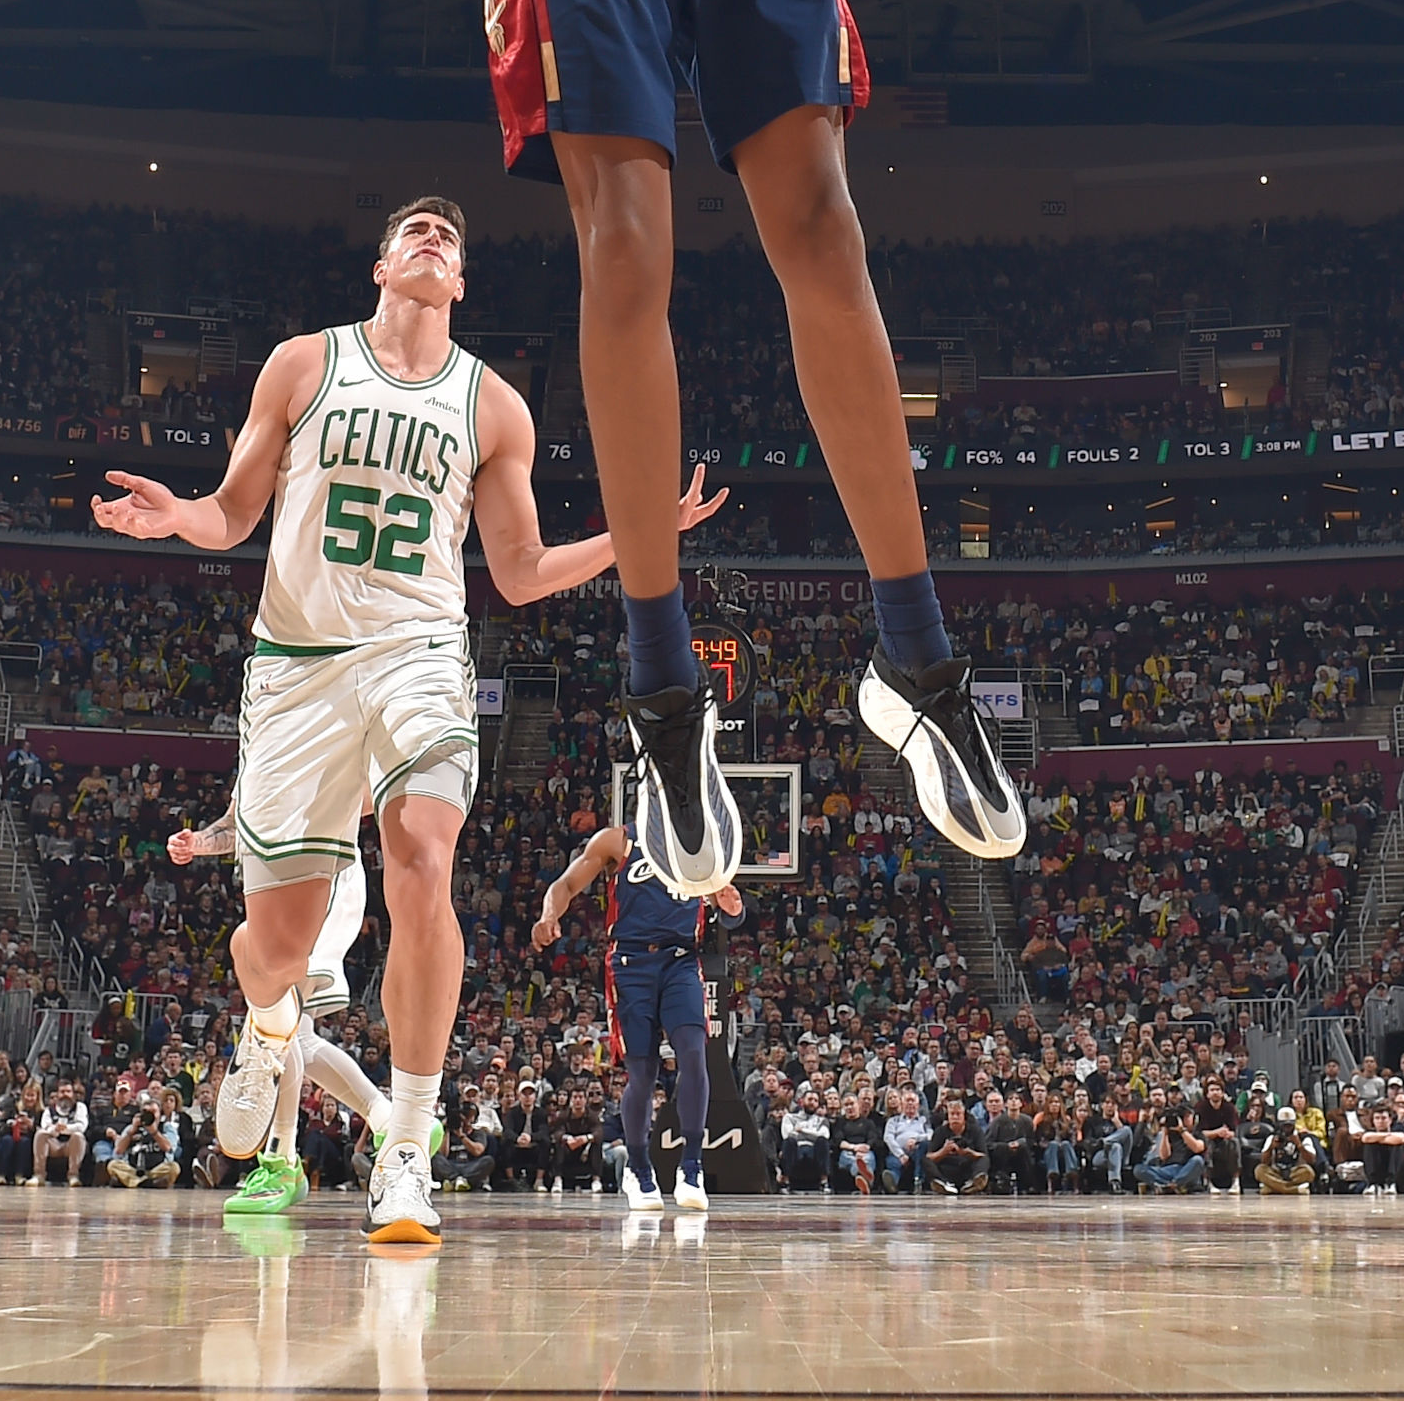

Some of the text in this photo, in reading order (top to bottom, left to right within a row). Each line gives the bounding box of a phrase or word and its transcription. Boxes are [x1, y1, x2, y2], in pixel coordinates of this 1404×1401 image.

[135, 316, 218, 332] 230 231
[526, 337, 544, 347] 201
[1263, 329, 1282, 339] 203
[424, 396, 460, 415] Amica
[68, 427, 87, 440] DIFF
[102, 425, 131, 441] -15
[164, 429, 211, 445] TOL 3
[1332, 430, 1389, 452] LET
[319, 408, 459, 495] CELTICS
[548, 444, 571, 460] 76
[1184, 442, 1231, 457] TOL 3
[1255, 440, 1301, 452] 3:08 PM
[688, 449, 721, 464] 9:49
[763, 450, 786, 466] 4Q
[965, 449, 1036, 465] FG% 44
[1067, 447, 1140, 464] FOULS 2
[323, 482, 434, 576] 52
[198, 564, 231, 576] M126
[1175, 572, 1208, 586] M102
